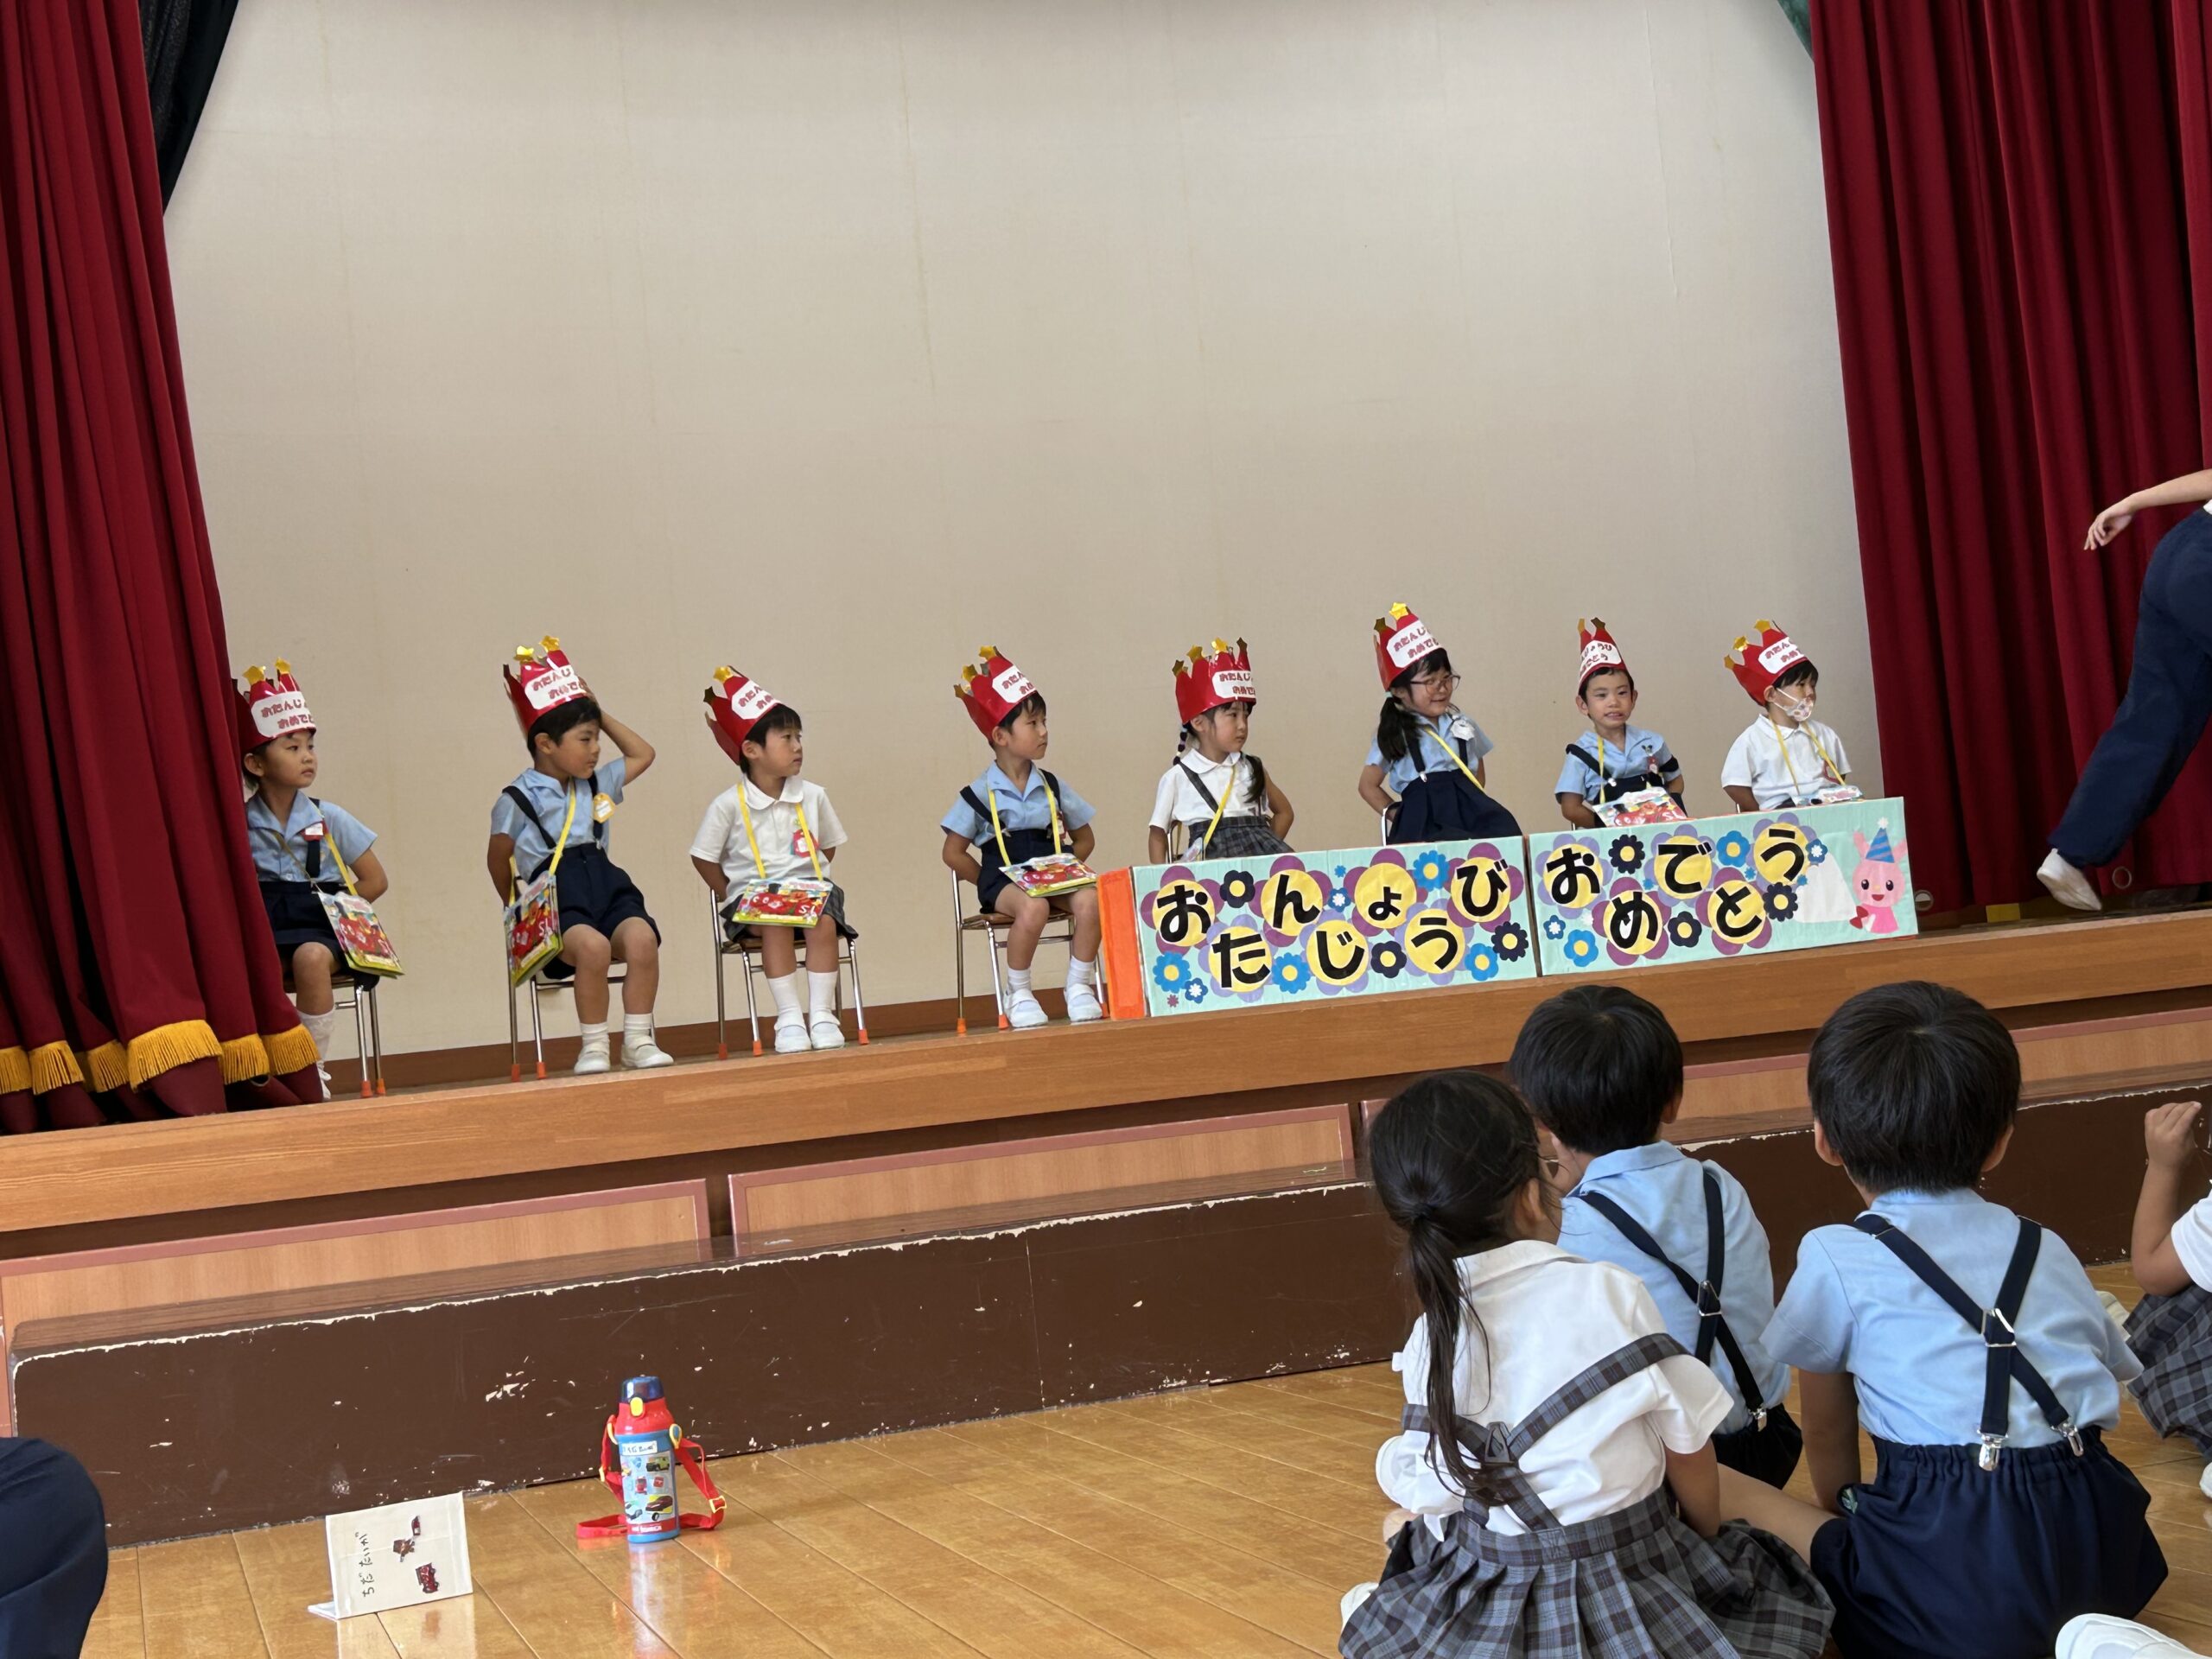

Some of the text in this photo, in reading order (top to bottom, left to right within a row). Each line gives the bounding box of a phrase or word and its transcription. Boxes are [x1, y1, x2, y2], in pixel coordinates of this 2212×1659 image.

[1393, 626, 1431, 652] おたんじ
[1219, 672, 1253, 682] おたんじ
[261, 699, 308, 718] おたんじ
